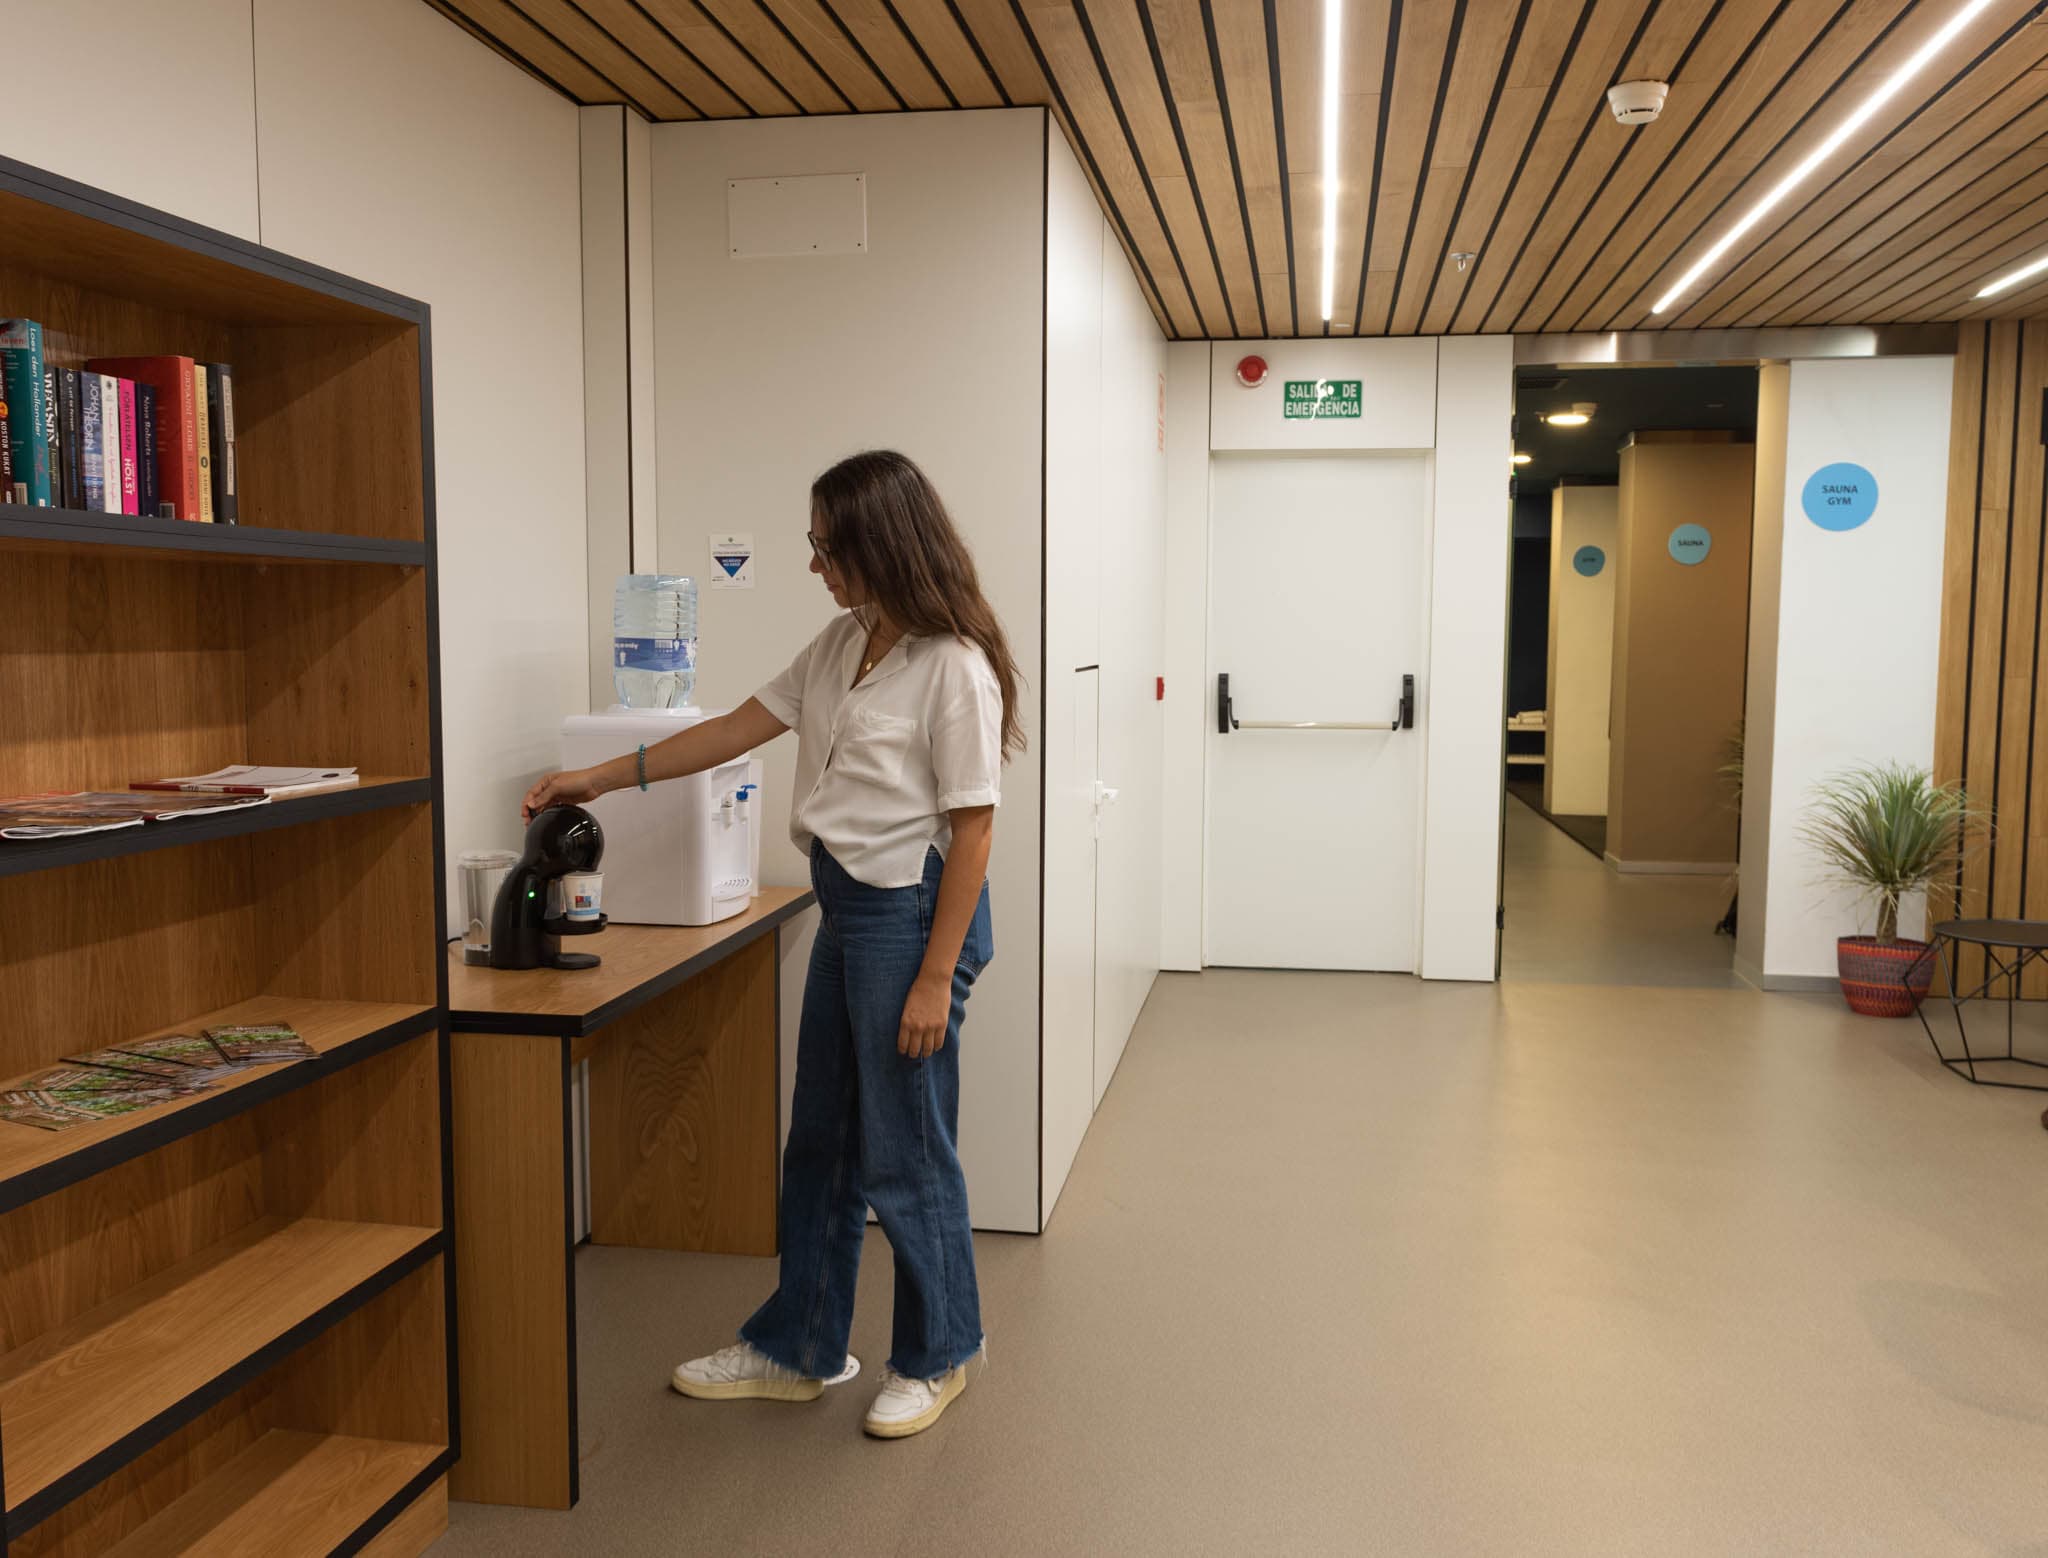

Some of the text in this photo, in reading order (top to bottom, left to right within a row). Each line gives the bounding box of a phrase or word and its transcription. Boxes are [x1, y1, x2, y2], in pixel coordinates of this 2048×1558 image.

[31, 356, 39, 378] den
[89, 383, 100, 422] JOHAN
[1342, 384, 1357, 398] DE
[32, 381, 43, 437] Hollander
[143, 395, 151, 419] Nora
[1285, 401, 1360, 416] EMERGENCIA
[83, 406, 95, 450] THEORIN
[144, 421, 152, 456] Roberts
[0, 420, 11, 476] KOSTON KUKAT
[124, 457, 133, 495] HOLST
[1821, 485, 1858, 495] SAUNA
[1826, 497, 1853, 506] GYM
[1677, 539, 1705, 547] SAUNA
